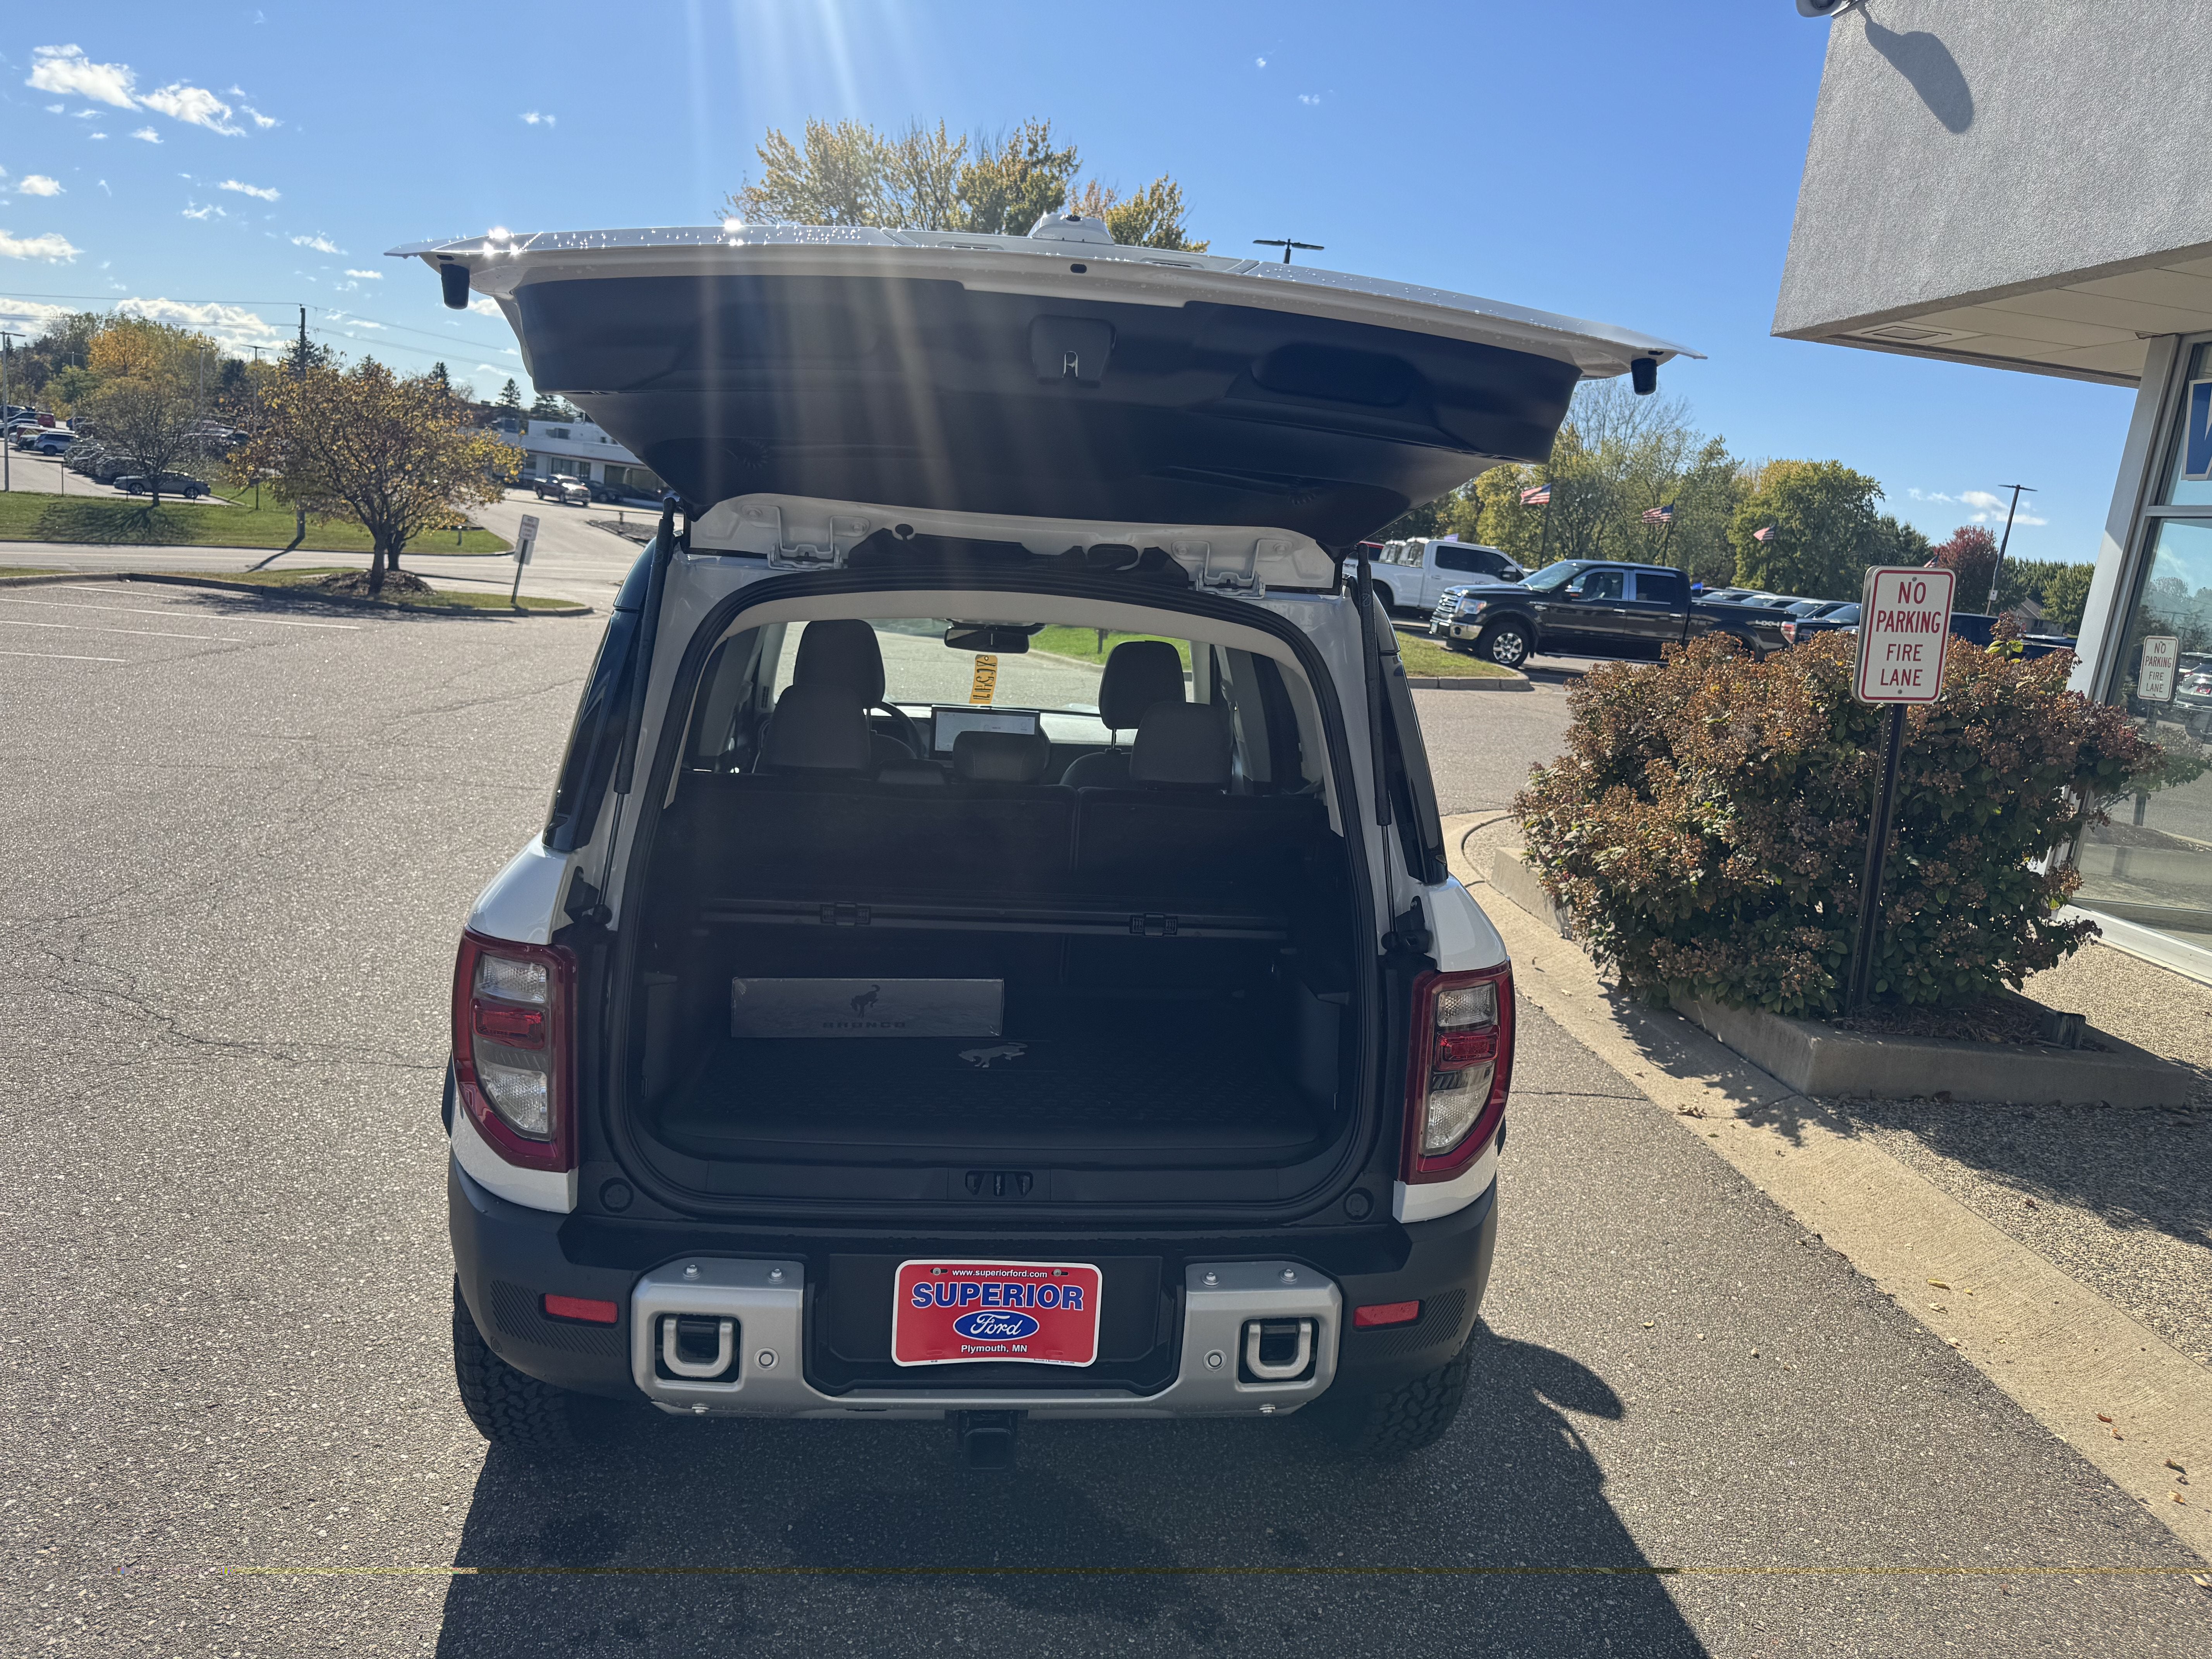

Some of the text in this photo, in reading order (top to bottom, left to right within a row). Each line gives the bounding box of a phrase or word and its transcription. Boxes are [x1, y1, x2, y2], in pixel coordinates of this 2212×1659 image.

[1898, 582, 1926, 604] NO
[1876, 610, 1941, 633] PARKING
[1886, 644, 1923, 661] FIRE
[2154, 643, 2166, 653] NO
[2145, 656, 2172, 668] PARKING
[1880, 668, 1923, 686] LANE
[2148, 672, 2164, 681] FIRE
[2146, 683, 2164, 692] LANE
[952, 1269, 1048, 1278] www.superiorford.com
[911, 1282, 1084, 1311] SUPERIOR
[970, 1314, 1022, 1336] Ford
[961, 1344, 1009, 1354] Plymouth,
